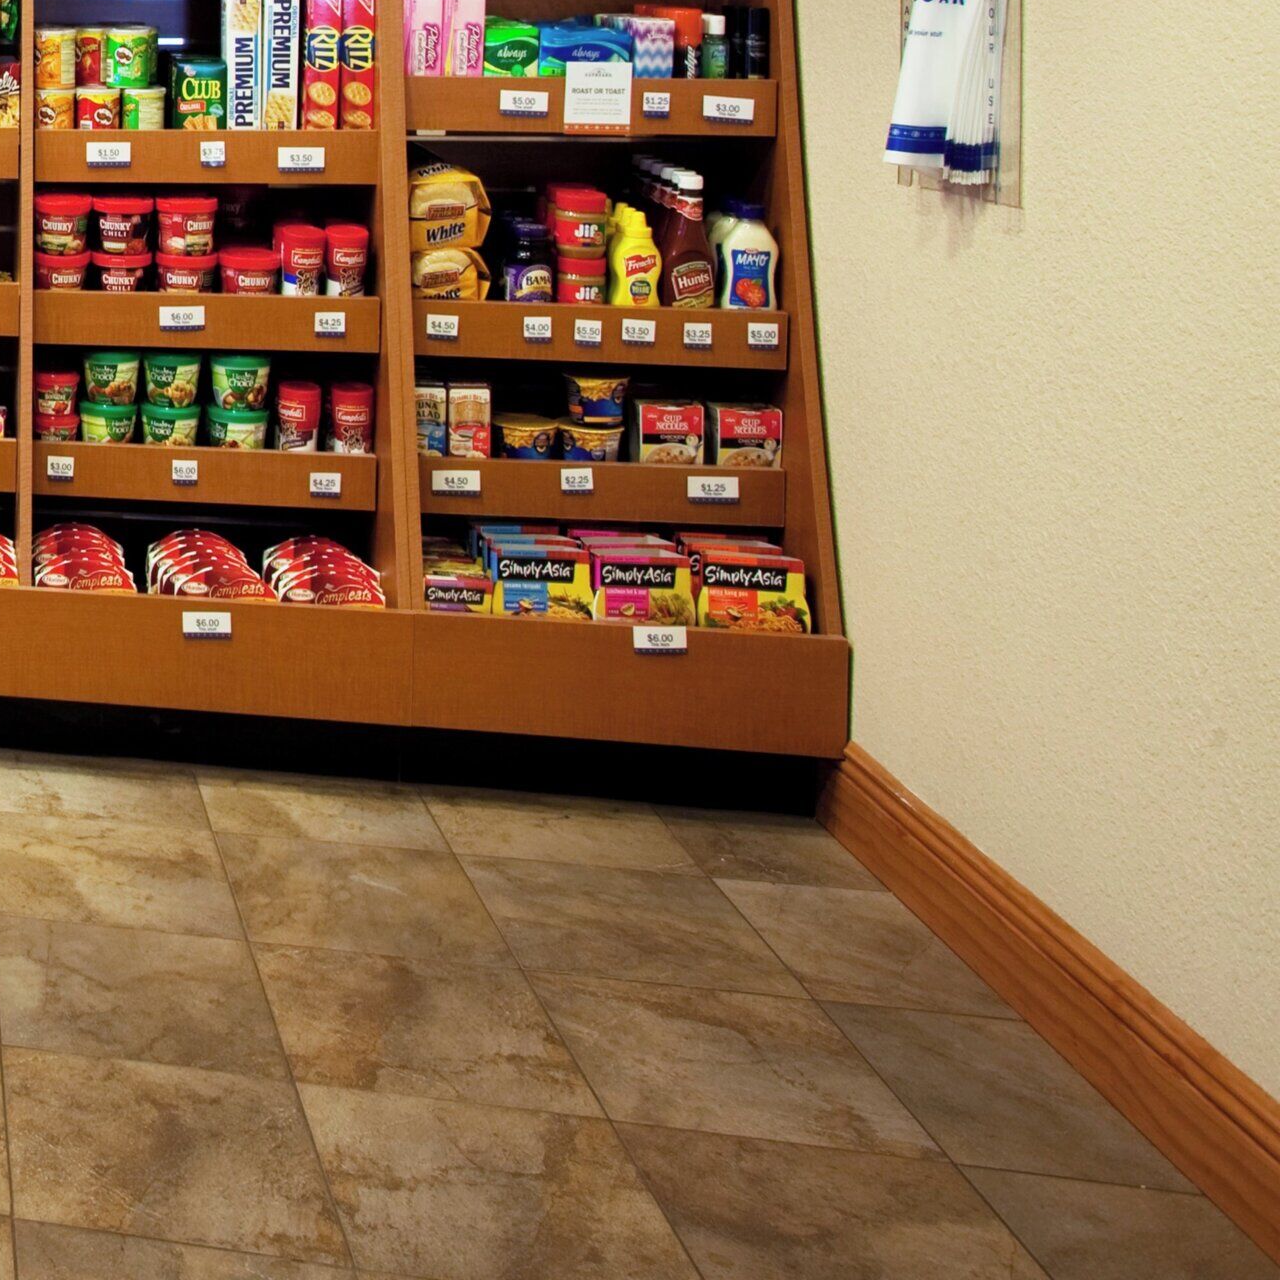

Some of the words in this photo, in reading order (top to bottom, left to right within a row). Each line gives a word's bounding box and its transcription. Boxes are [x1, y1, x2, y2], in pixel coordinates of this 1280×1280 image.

[310, 30, 339, 71] RITZ
[344, 30, 374, 71] RITZ
[497, 45, 528, 61] always
[571, 46, 600, 60] always
[235, 37, 254, 127] PREMIUM
[181, 77, 222, 101] CLUB
[571, 87, 592, 95] ROAST
[593, 87, 604, 95] OR
[605, 87, 626, 96] TOAST
[512, 96, 536, 106] $5.00
[644, 96, 669, 106] $1.25
[987, 78, 995, 126] USE
[715, 103, 741, 114] $3.00
[97, 148, 120, 158] $1.50
[290, 154, 313, 164] $3.50
[42, 218, 73, 232] CHUNKY
[99, 218, 132, 232] CHUNKY
[102, 229, 128, 238] CHILI
[426, 221, 466, 243] White
[574, 223, 599, 239] Jif
[736, 252, 768, 268] MAYO
[52, 273, 82, 285] CHUNKY
[102, 273, 135, 286] CHUNKY
[166, 273, 199, 286] CHUNKY
[238, 275, 269, 288] CHUNKY
[677, 272, 710, 290] Hunt's
[575, 285, 599, 300] Jif
[171, 312, 194, 322] $6.00
[318, 318, 342, 328] $4.25
[431, 320, 456, 330] $4.50
[524, 323, 550, 332] $4.00
[576, 326, 600, 336] $5.50
[624, 325, 650, 336] $3.50
[685, 329, 711, 339] $3.25
[750, 330, 777, 340] $5.00
[91, 371, 115, 382] Choice
[150, 371, 176, 382] Choice
[228, 377, 254, 388] Choice
[416, 399, 439, 410] UNA
[416, 410, 440, 420] ALAD
[663, 414, 682, 423] CUP
[656, 421, 689, 431] NOODLES
[741, 418, 761, 427] CUP
[108, 424, 130, 435] Choice
[149, 426, 172, 436] Choice
[733, 425, 768, 435] NOODLES
[50, 462, 72, 472] $3.00
[174, 466, 196, 476] $6.00
[313, 478, 336, 488] $4.25
[444, 476, 469, 486] $4.50
[564, 475, 589, 485] $2.25
[700, 483, 727, 493] $1.25
[69, 574, 123, 592] Compleats
[209, 582, 265, 600] Compleats
[315, 587, 372, 607] Compleats
[195, 617, 220, 628] $6.00
[647, 633, 674, 643] $6.00
